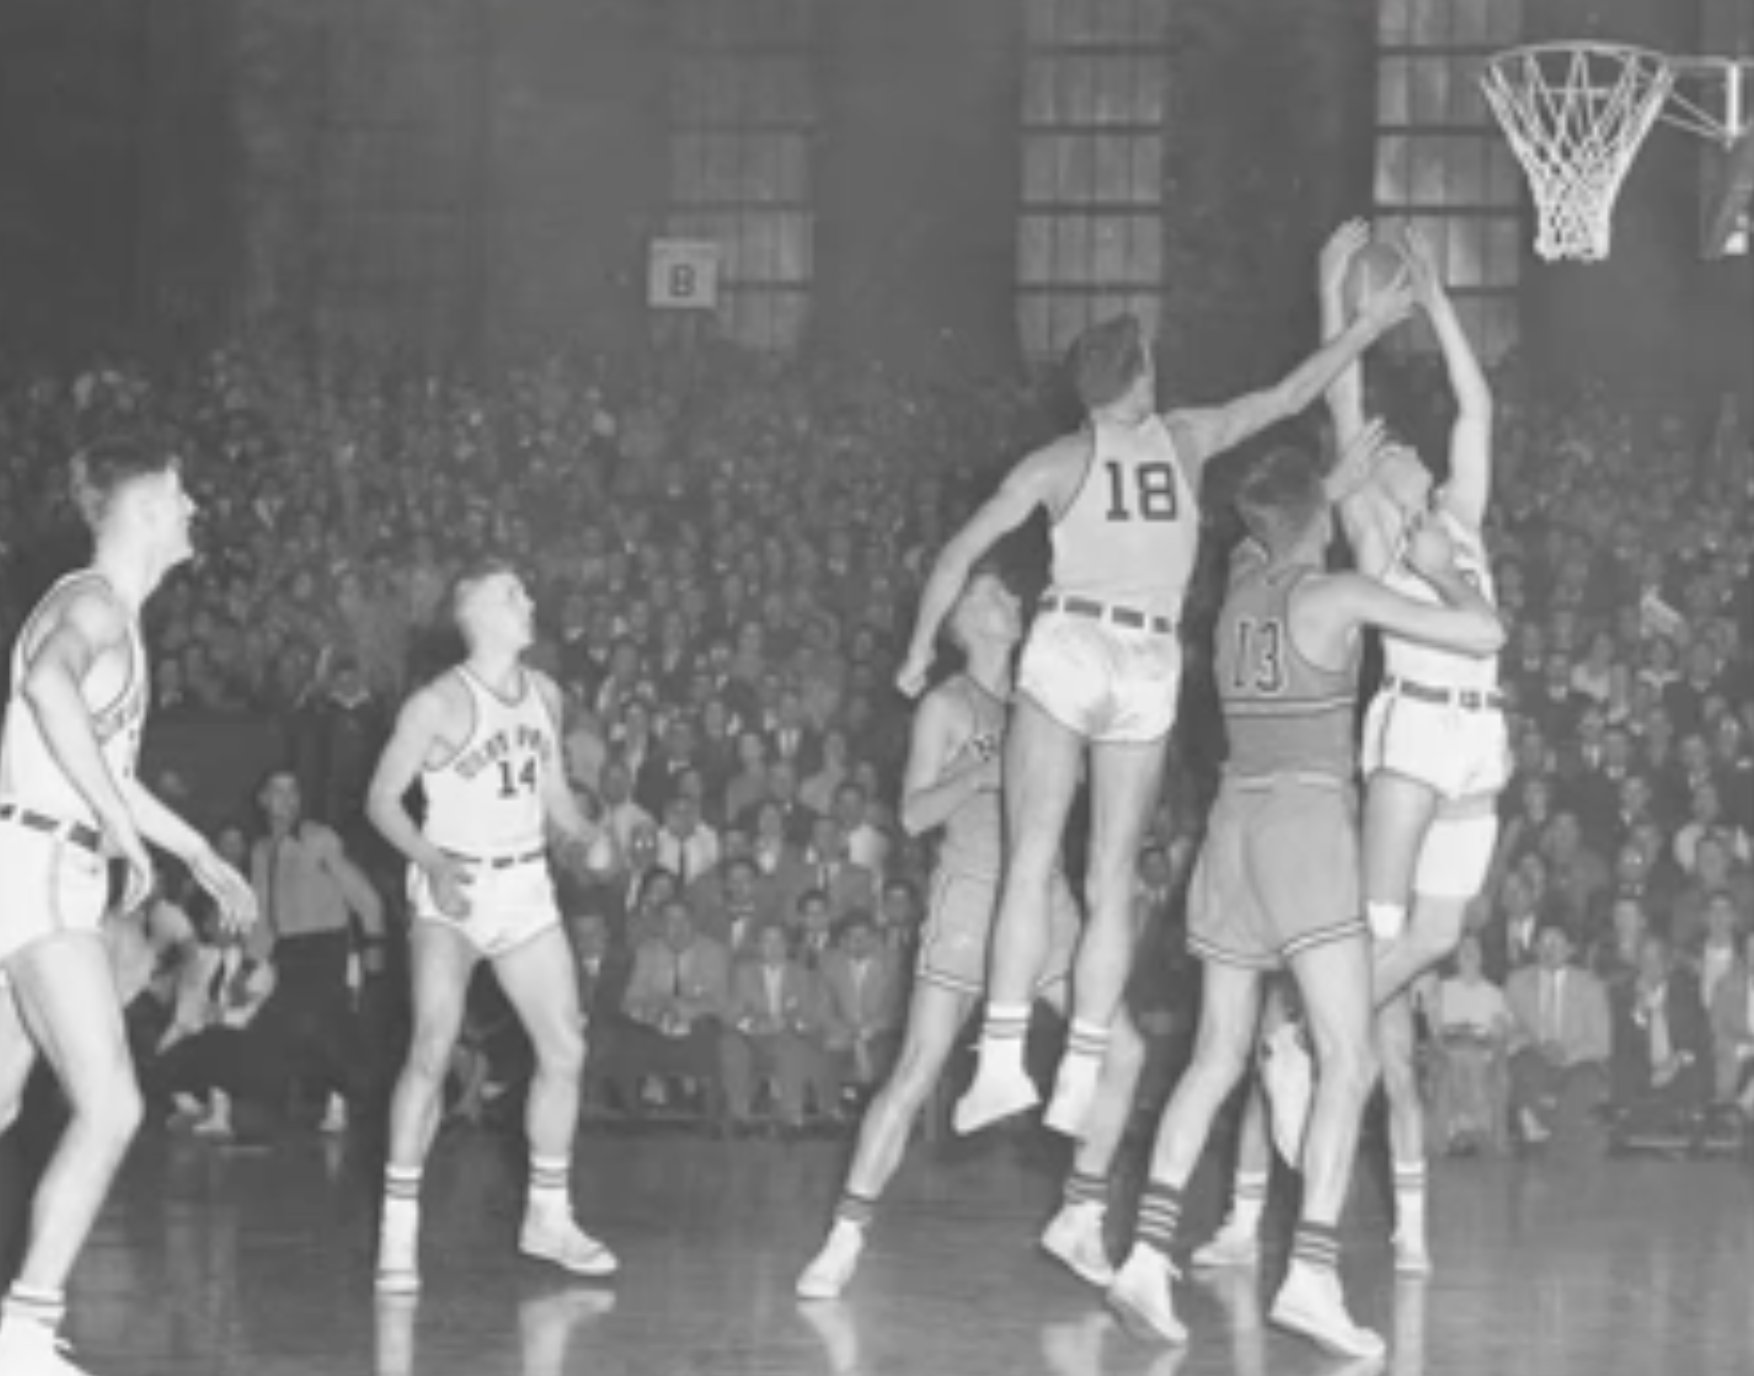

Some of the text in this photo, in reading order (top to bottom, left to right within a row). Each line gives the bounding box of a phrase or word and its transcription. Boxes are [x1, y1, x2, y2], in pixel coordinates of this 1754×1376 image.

[1104, 461, 1177, 522] 18
[1232, 617, 1287, 694] 13
[497, 757, 536, 799] 14
